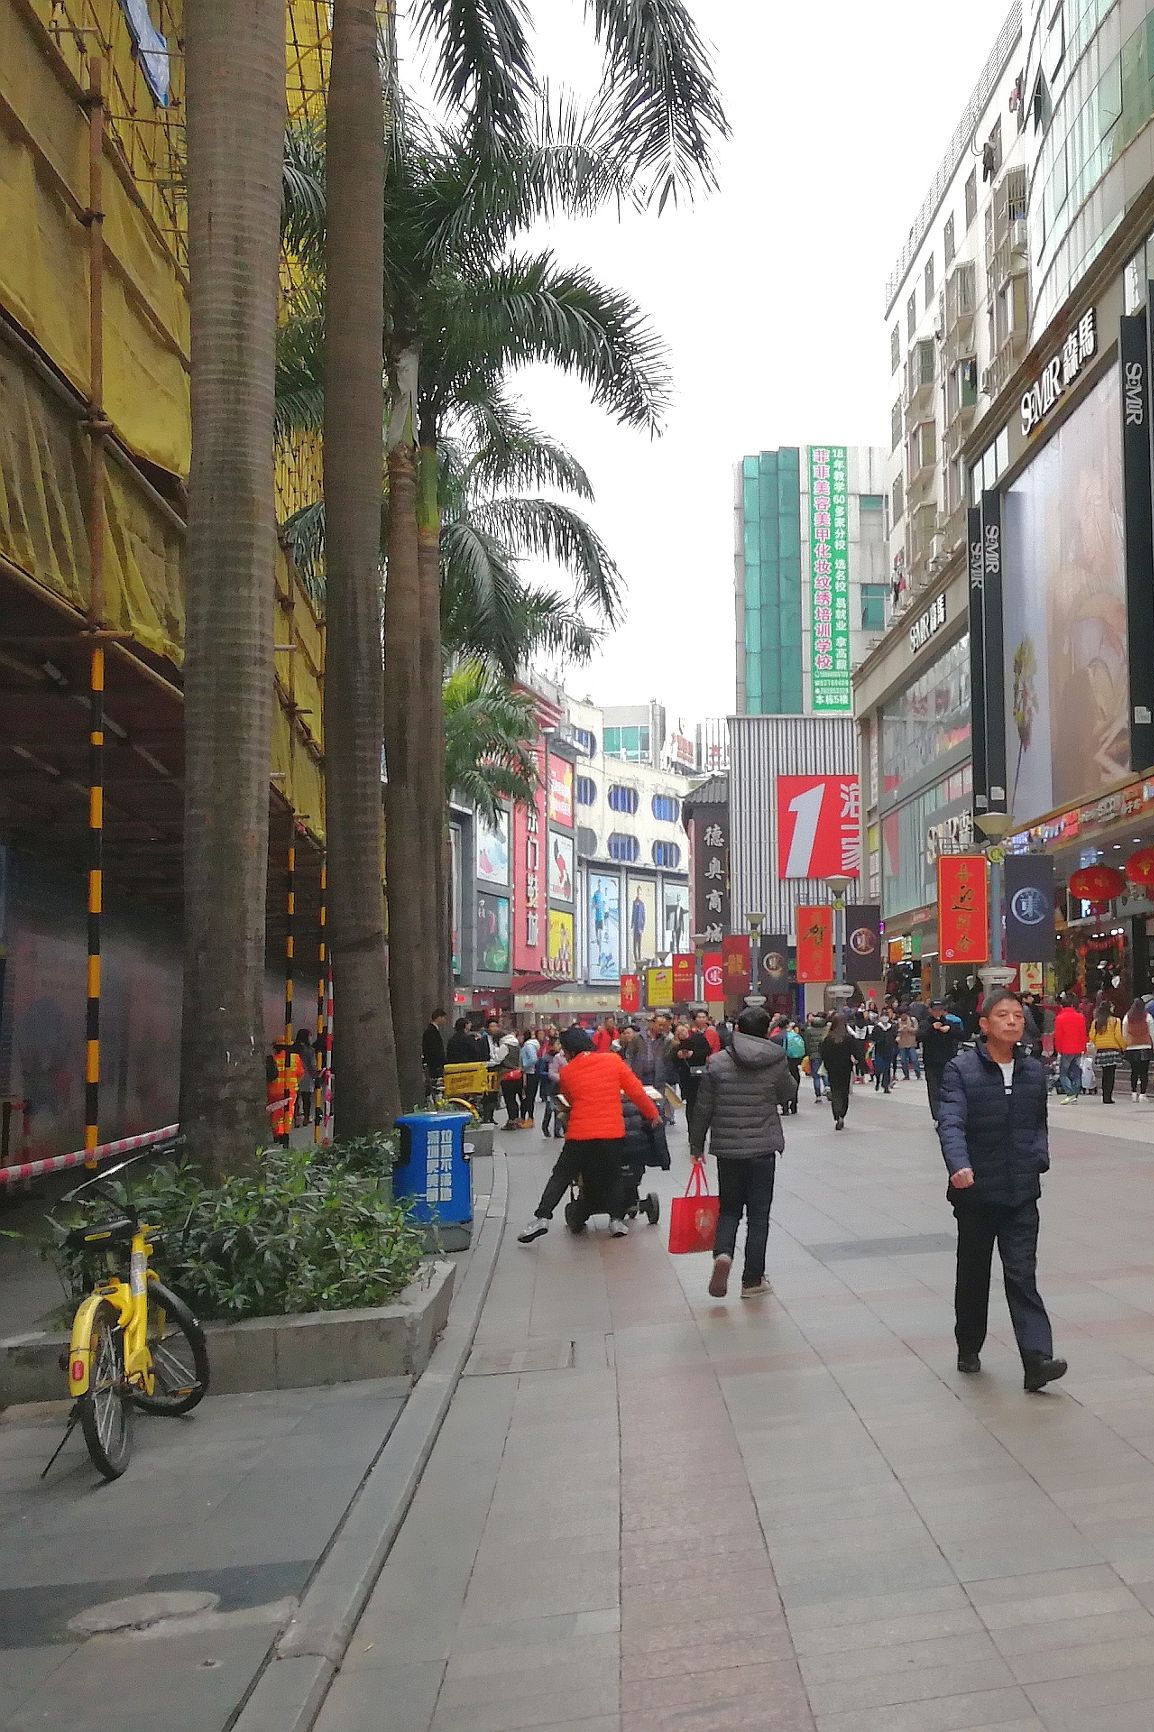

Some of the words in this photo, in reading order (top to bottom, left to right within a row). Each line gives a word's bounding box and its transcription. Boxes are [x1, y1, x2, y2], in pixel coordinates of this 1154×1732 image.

[1020, 356, 1063, 436] SEMIR
[1062, 307, 1095, 386] 森馬
[1126, 362, 1144, 426] SEMIR
[785, 783, 826, 878] 1
